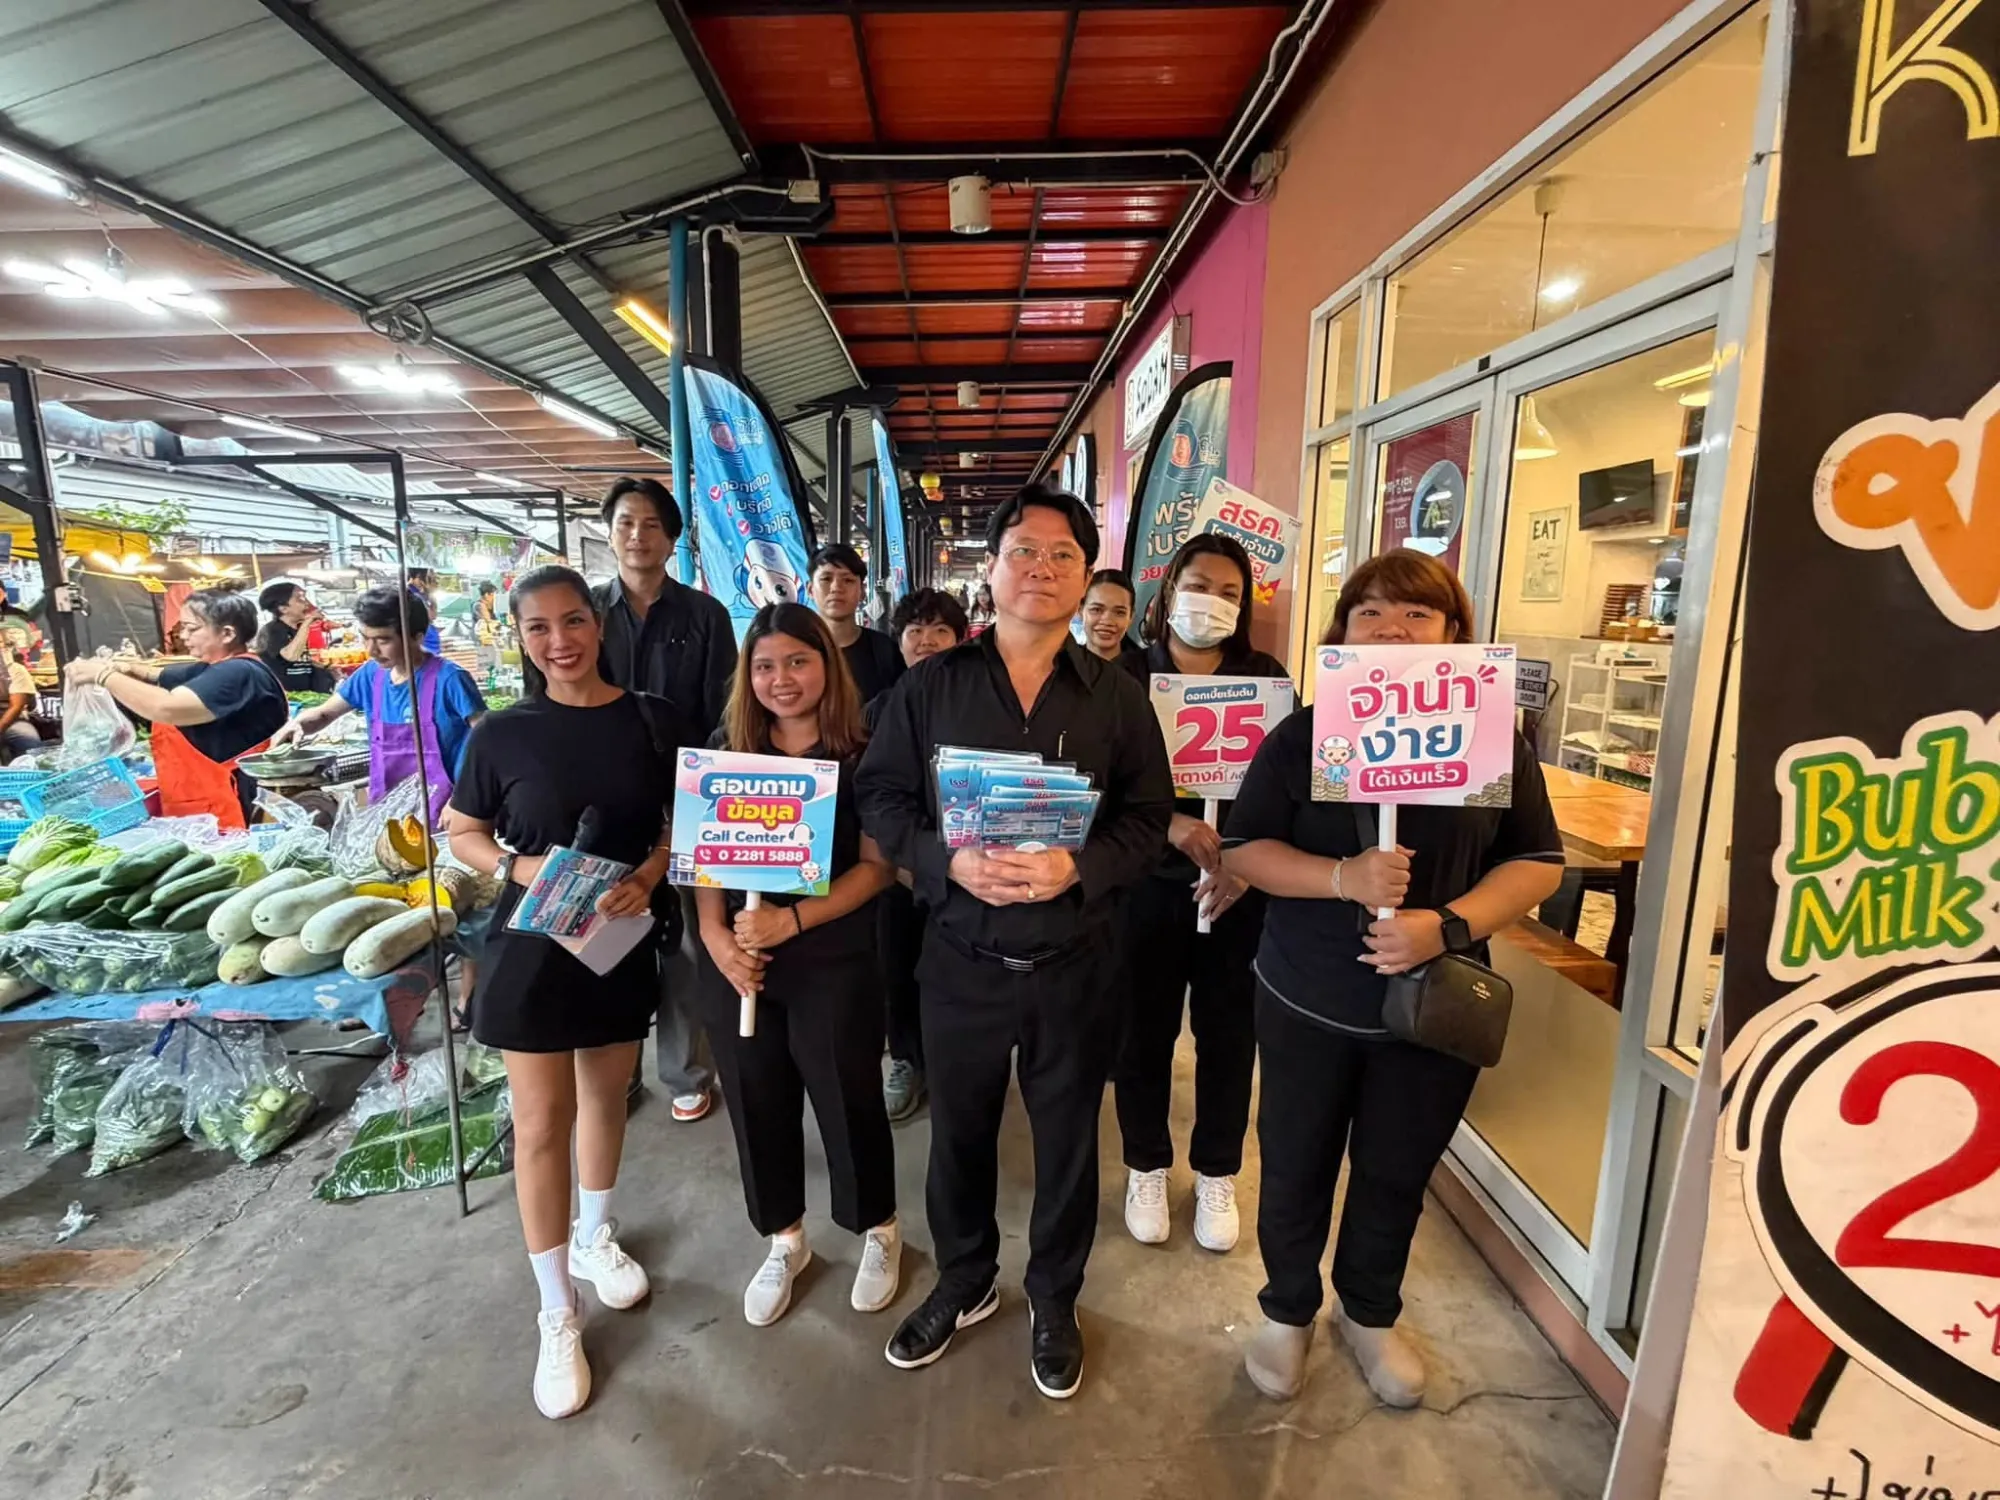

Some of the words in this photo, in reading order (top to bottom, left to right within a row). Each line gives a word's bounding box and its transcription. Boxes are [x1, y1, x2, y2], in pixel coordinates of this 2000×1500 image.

[1532, 518, 1562, 540] EAT
[1520, 667, 1543, 678] PLEASE
[1185, 686, 1254, 702] ดอกเบี้ยเริ่มต้น
[1350, 661, 1476, 719] จำนำ
[1172, 703, 1265, 764] 25
[1361, 716, 1463, 763] ง่าย
[709, 778, 806, 796] สอบถาม
[1366, 763, 1460, 788] ได้เงินเร็ว
[726, 797, 795, 827] ข้อมูล
[701, 830, 730, 842] Call
[735, 831, 786, 844] Center
[718, 852, 728, 862] 0
[733, 852, 764, 862] 2281
[768, 853, 804, 862] 5888
[1790, 861, 1972, 959] Milk
